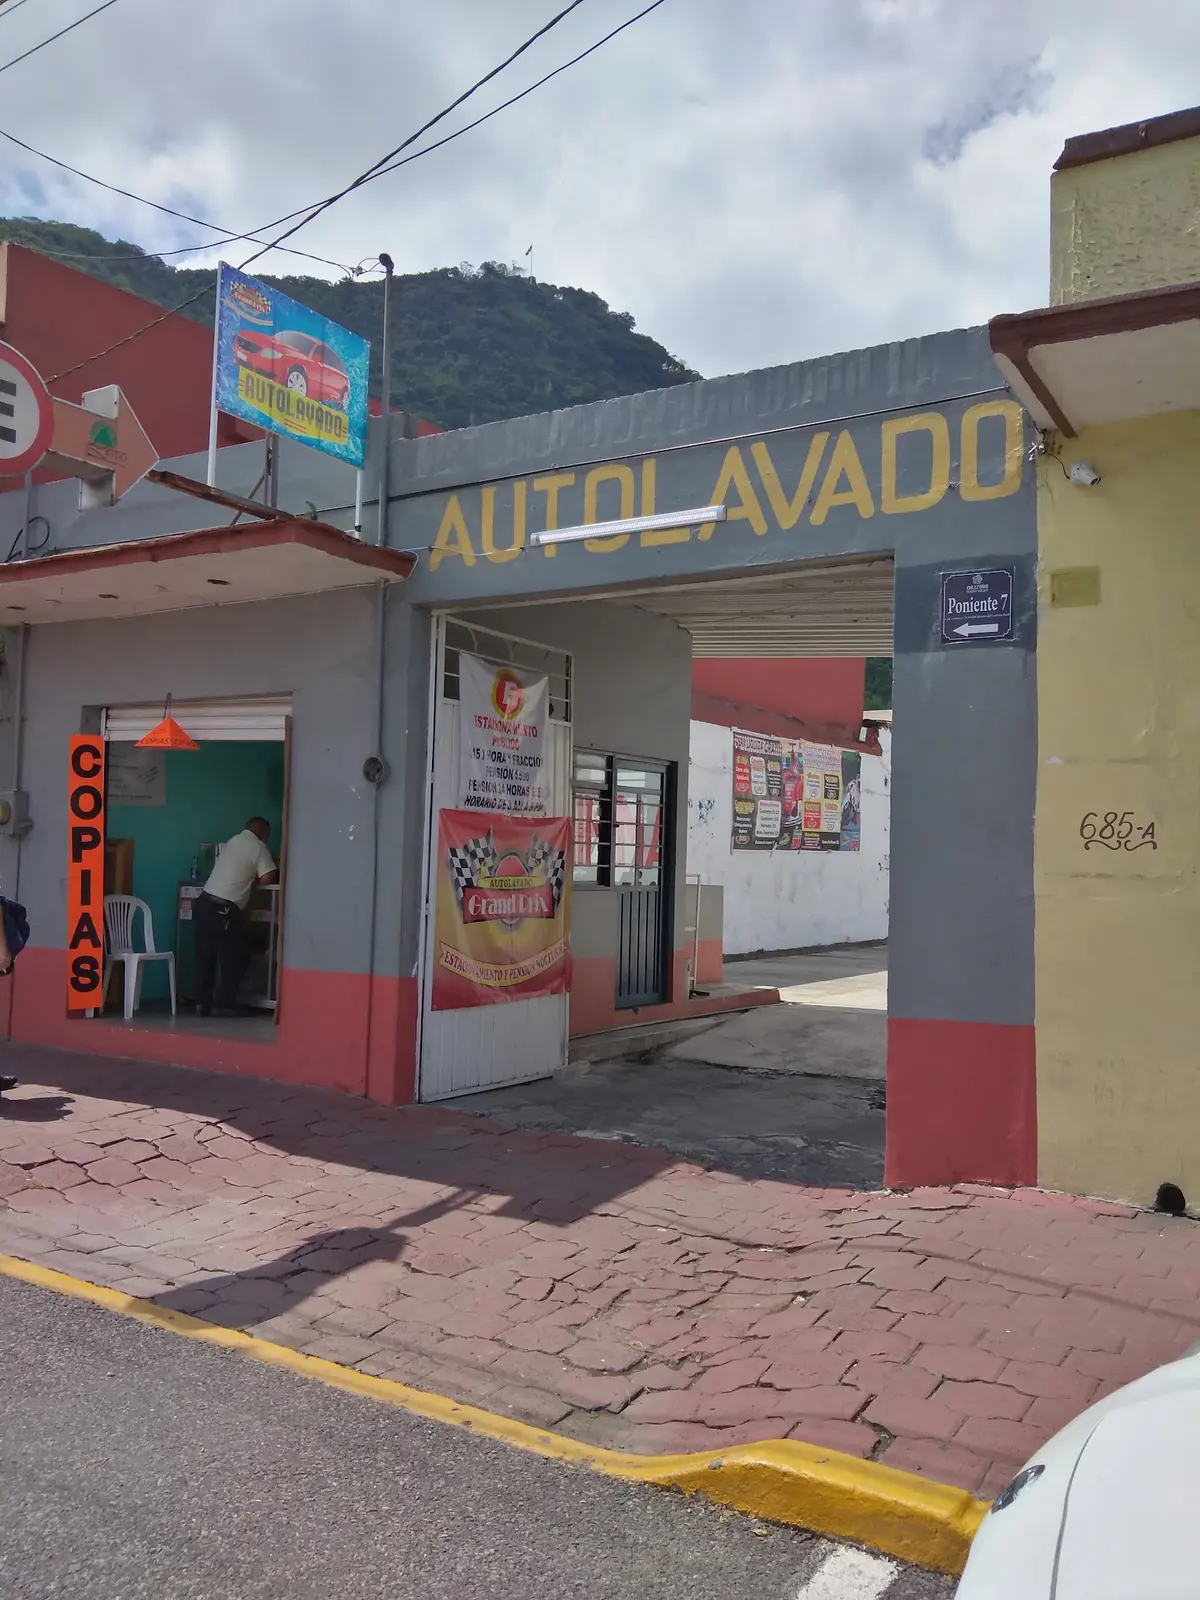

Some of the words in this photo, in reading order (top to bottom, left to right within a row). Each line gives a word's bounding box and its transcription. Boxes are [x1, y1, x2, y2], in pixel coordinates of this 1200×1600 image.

[244, 373, 344, 438] AUTOLAVADO
[428, 399, 1025, 571] AUTOLAVADO
[947, 596, 999, 615] Poniente
[1000, 593, 1009, 611] 7
[1080, 811, 1155, 840] 685-A
[69, 744, 103, 993] COPIAS
[489, 878, 533, 888] AUTOLAVADO
[468, 893, 516, 916] Grand
[518, 892, 549, 914] Prix
